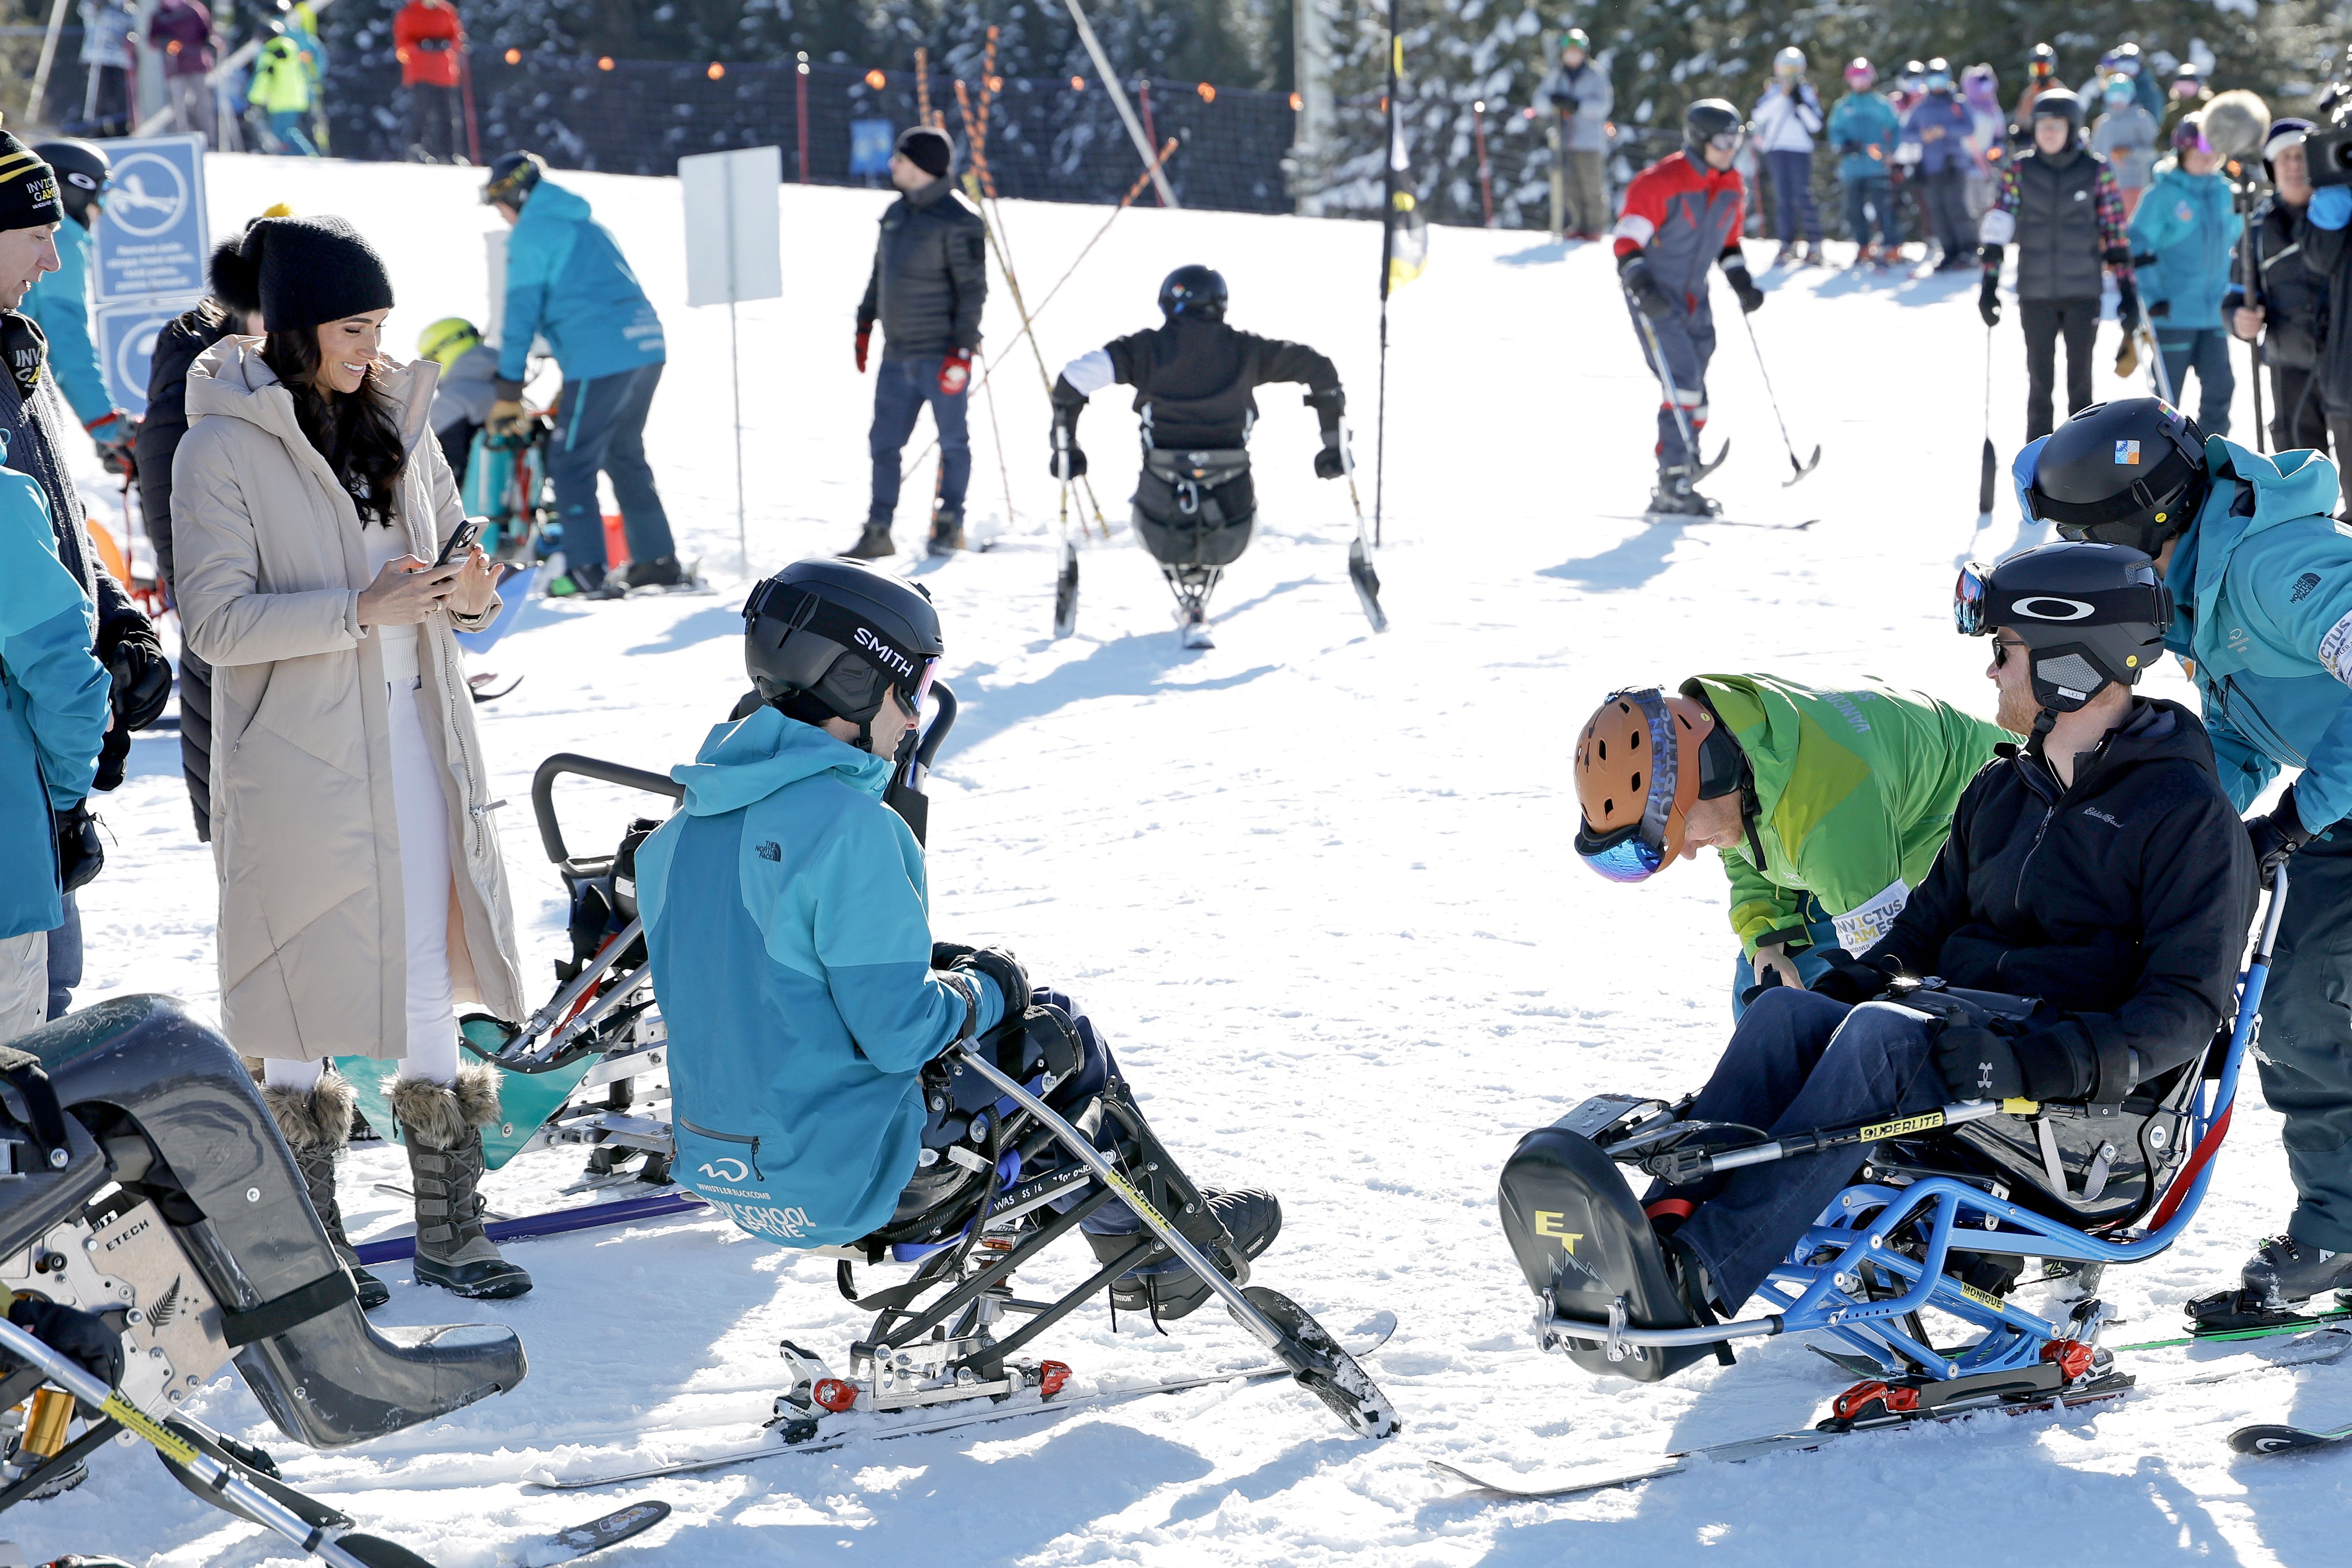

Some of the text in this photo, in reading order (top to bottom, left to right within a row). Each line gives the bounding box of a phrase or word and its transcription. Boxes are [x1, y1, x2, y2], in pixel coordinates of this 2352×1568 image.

[2290, 580, 2310, 604] NORTH
[2292, 578, 2304, 591] THE
[2299, 585, 2315, 601] FACE
[854, 627, 914, 678] SMITH
[1659, 708, 1678, 821] OPTICS
[755, 844, 774, 856] NORTH
[759, 852, 774, 861] FACE
[1864, 1114, 1940, 1140] SUPERLITE
[734, 1203, 816, 1227] SCHOOL
[106, 1219, 149, 1252] ETECH
[1962, 1284, 2002, 1308] MONIQUE
[790, 1406, 812, 1418] HEAD
